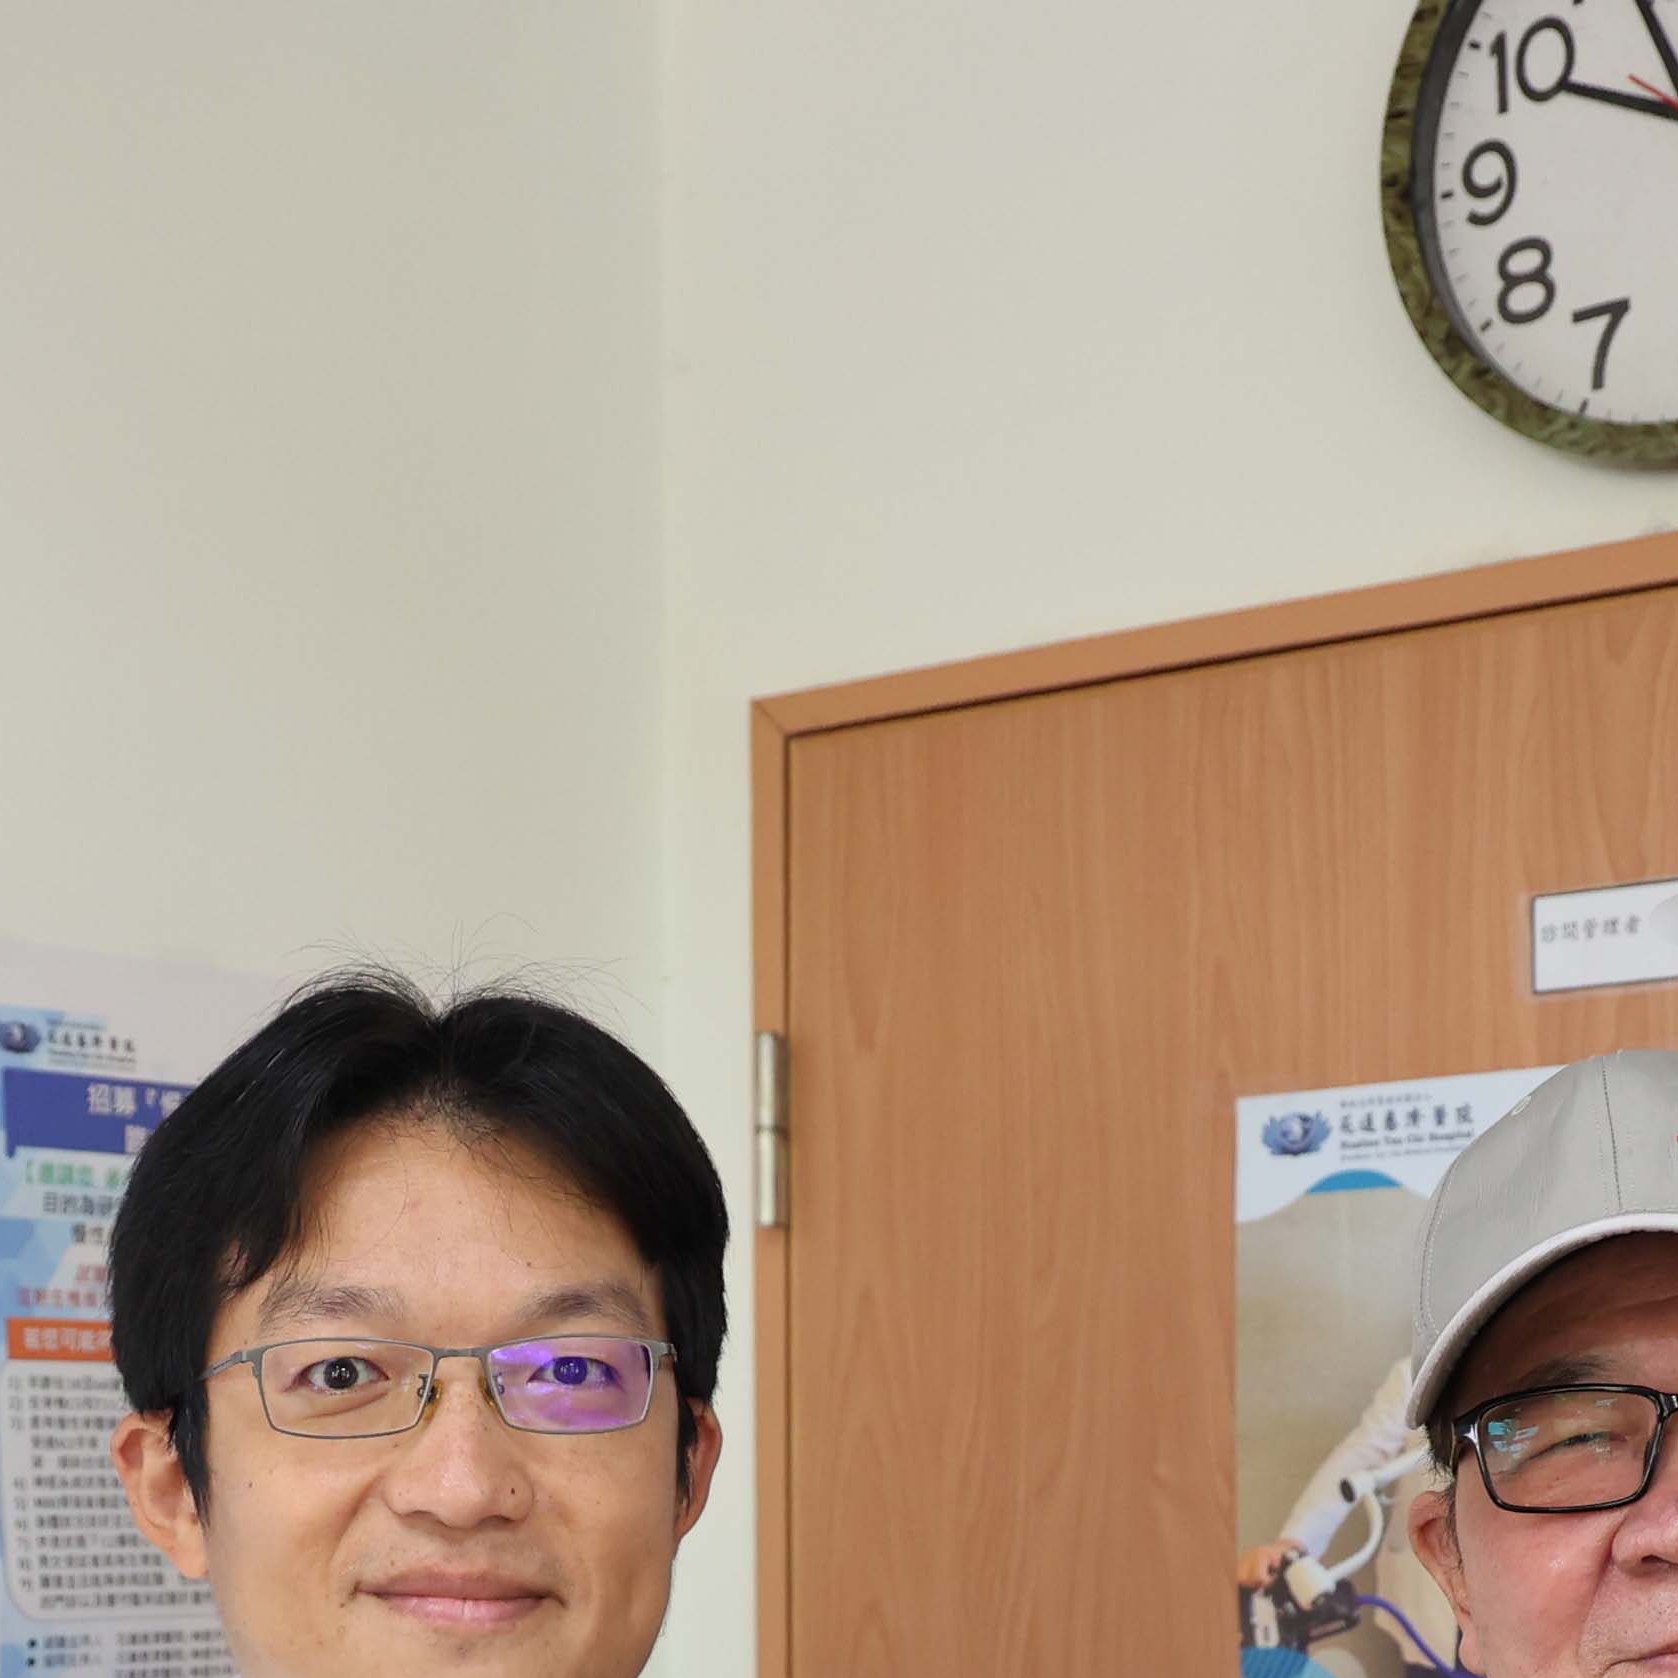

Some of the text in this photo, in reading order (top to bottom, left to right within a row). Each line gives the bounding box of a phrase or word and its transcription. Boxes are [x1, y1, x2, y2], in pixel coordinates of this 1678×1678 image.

[1490, 17, 1574, 114] 10
[1462, 140, 1517, 226] 9
[1496, 237, 1556, 325] 8
[1573, 298, 1631, 391] 7
